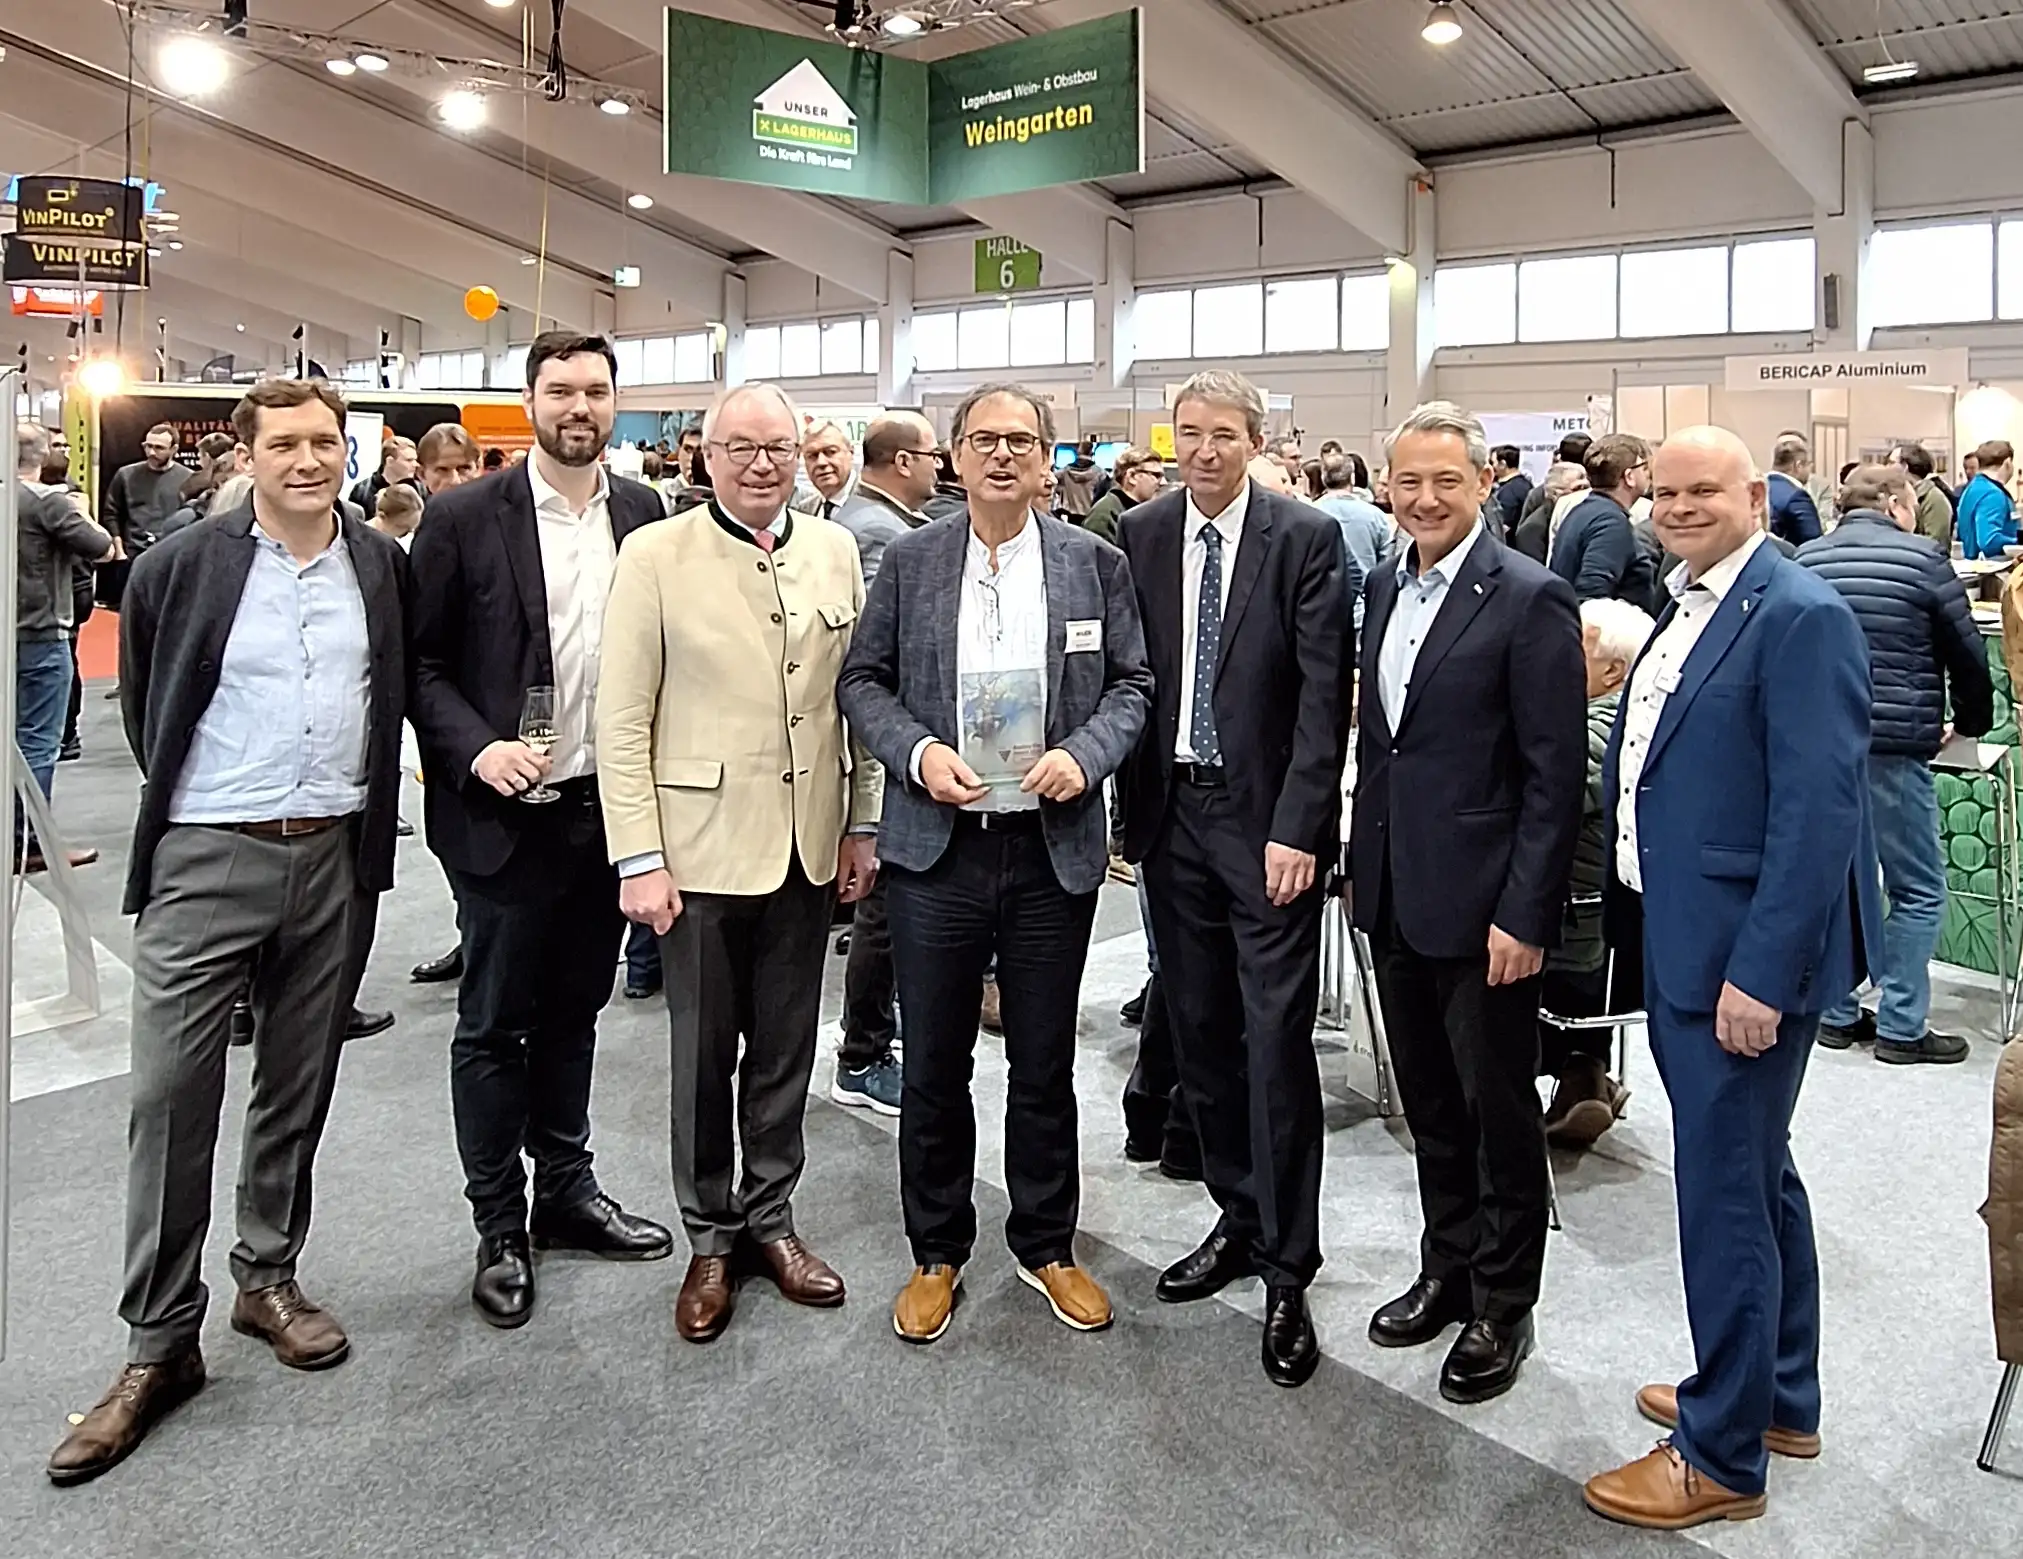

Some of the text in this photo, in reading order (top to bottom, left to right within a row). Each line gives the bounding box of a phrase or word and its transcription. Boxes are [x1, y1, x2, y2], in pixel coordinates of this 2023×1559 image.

[962, 89, 1013, 110] Lagerhaus
[1044, 77, 1051, 91] &
[1053, 68, 1097, 89] Obstbau
[784, 101, 828, 117] UNSER
[773, 121, 852, 145] LAGERHAUS
[965, 103, 1093, 147] Weingarten
[760, 145, 777, 158] Die
[778, 147, 805, 163] Kraft
[828, 155, 852, 170] Land
[1000, 259, 1014, 289] 6
[1760, 362, 1927, 379] BERICAP Aluminium
